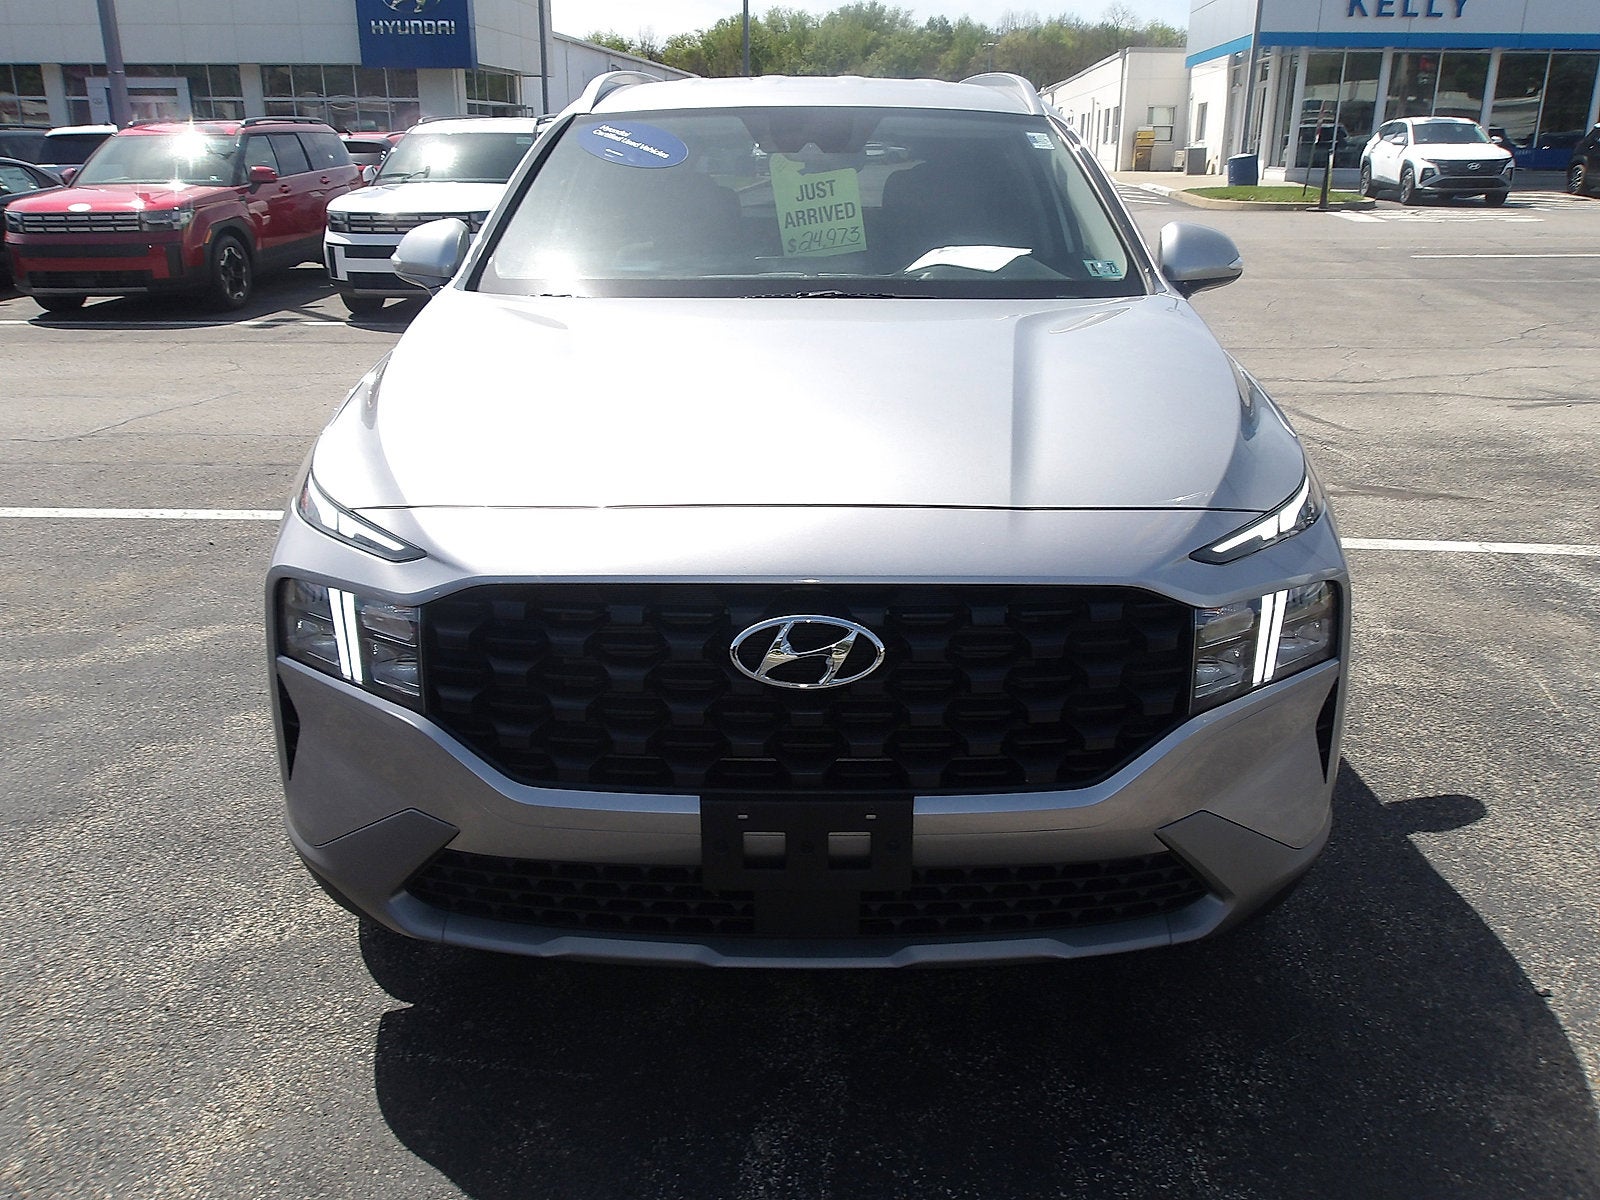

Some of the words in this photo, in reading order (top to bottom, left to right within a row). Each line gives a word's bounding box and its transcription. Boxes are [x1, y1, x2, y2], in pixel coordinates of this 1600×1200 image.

[370, 20, 456, 35] HYUNDAI
[796, 180, 836, 202] JUST
[784, 202, 856, 229] ARRIVED
